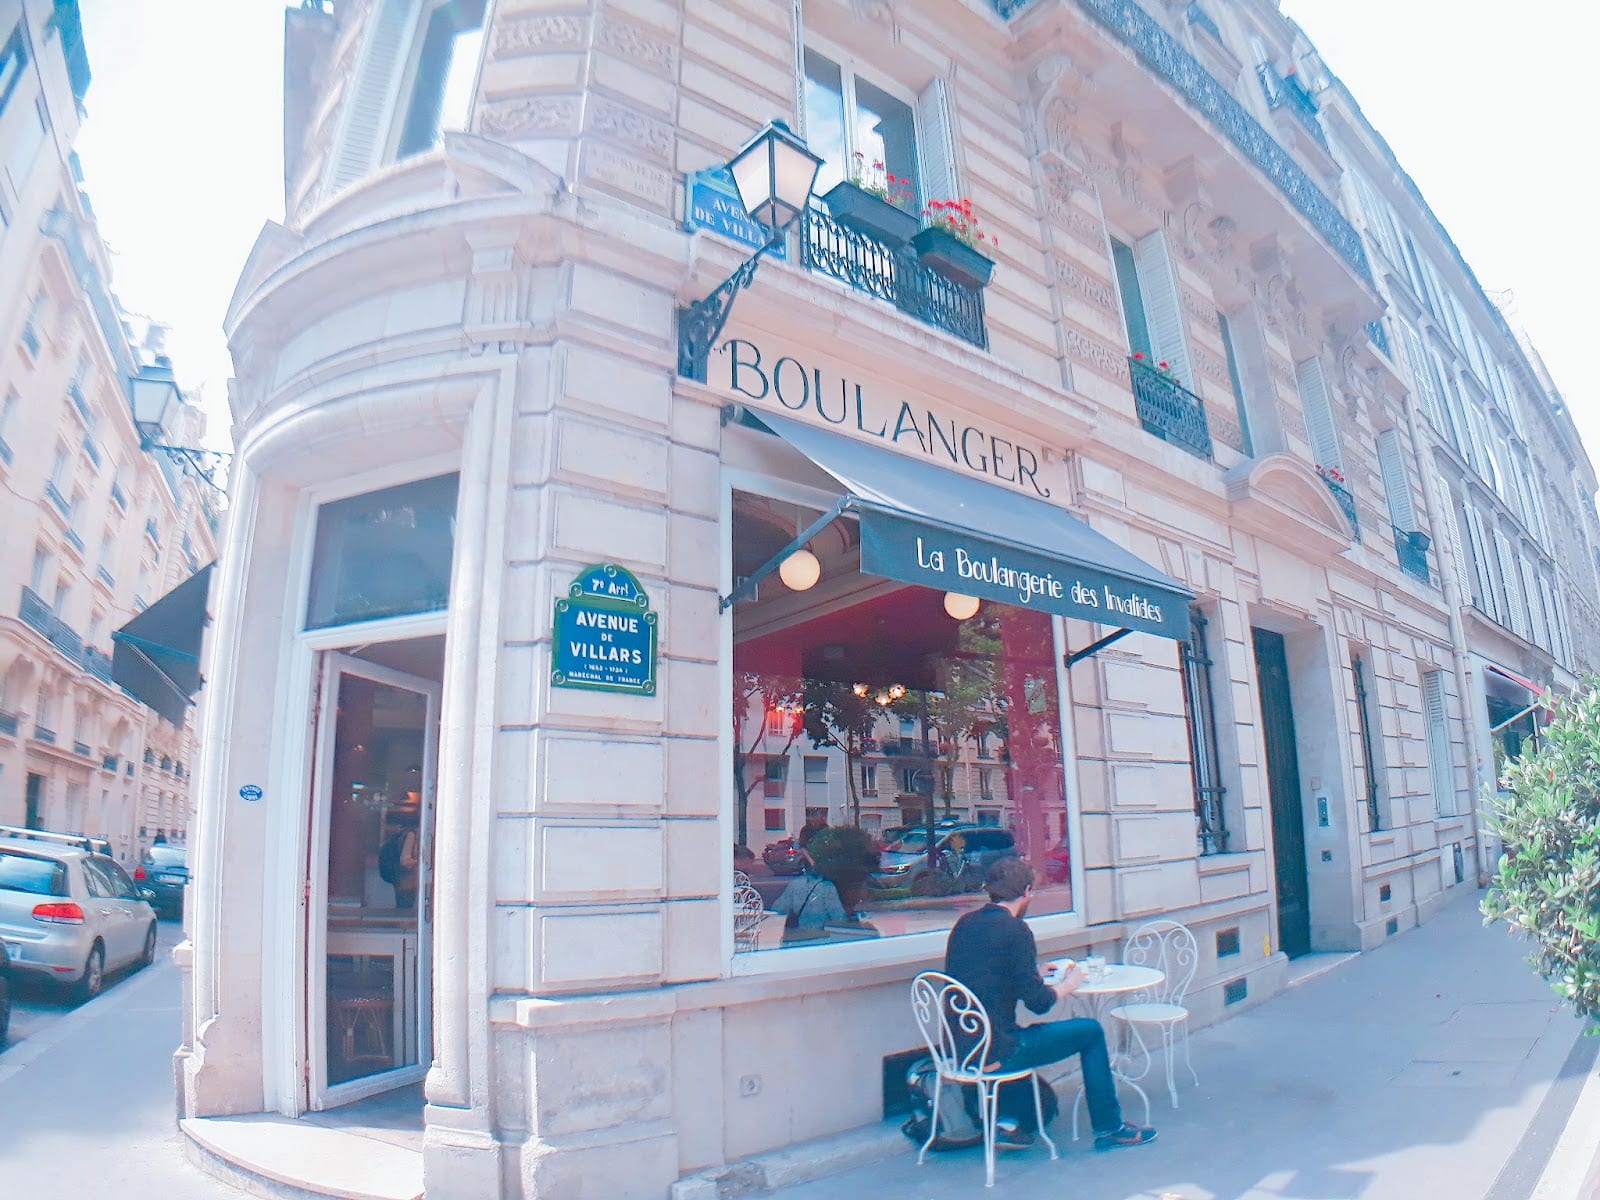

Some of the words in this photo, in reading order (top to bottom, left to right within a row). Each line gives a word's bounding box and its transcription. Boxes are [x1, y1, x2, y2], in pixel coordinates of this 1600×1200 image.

[694, 206, 715, 226] DE
[722, 216, 785, 256] VILLAS
[713, 199, 769, 231] AVEN
[722, 339, 1050, 498] BOULANGER
[915, 537, 944, 572] La
[955, 548, 1063, 603] Boulangerie
[1071, 581, 1098, 608] des
[1104, 585, 1162, 623] Invalides
[576, 611, 638, 633] AVENUE
[601, 633, 613, 642] DE
[570, 641, 642, 664] VILLARS
